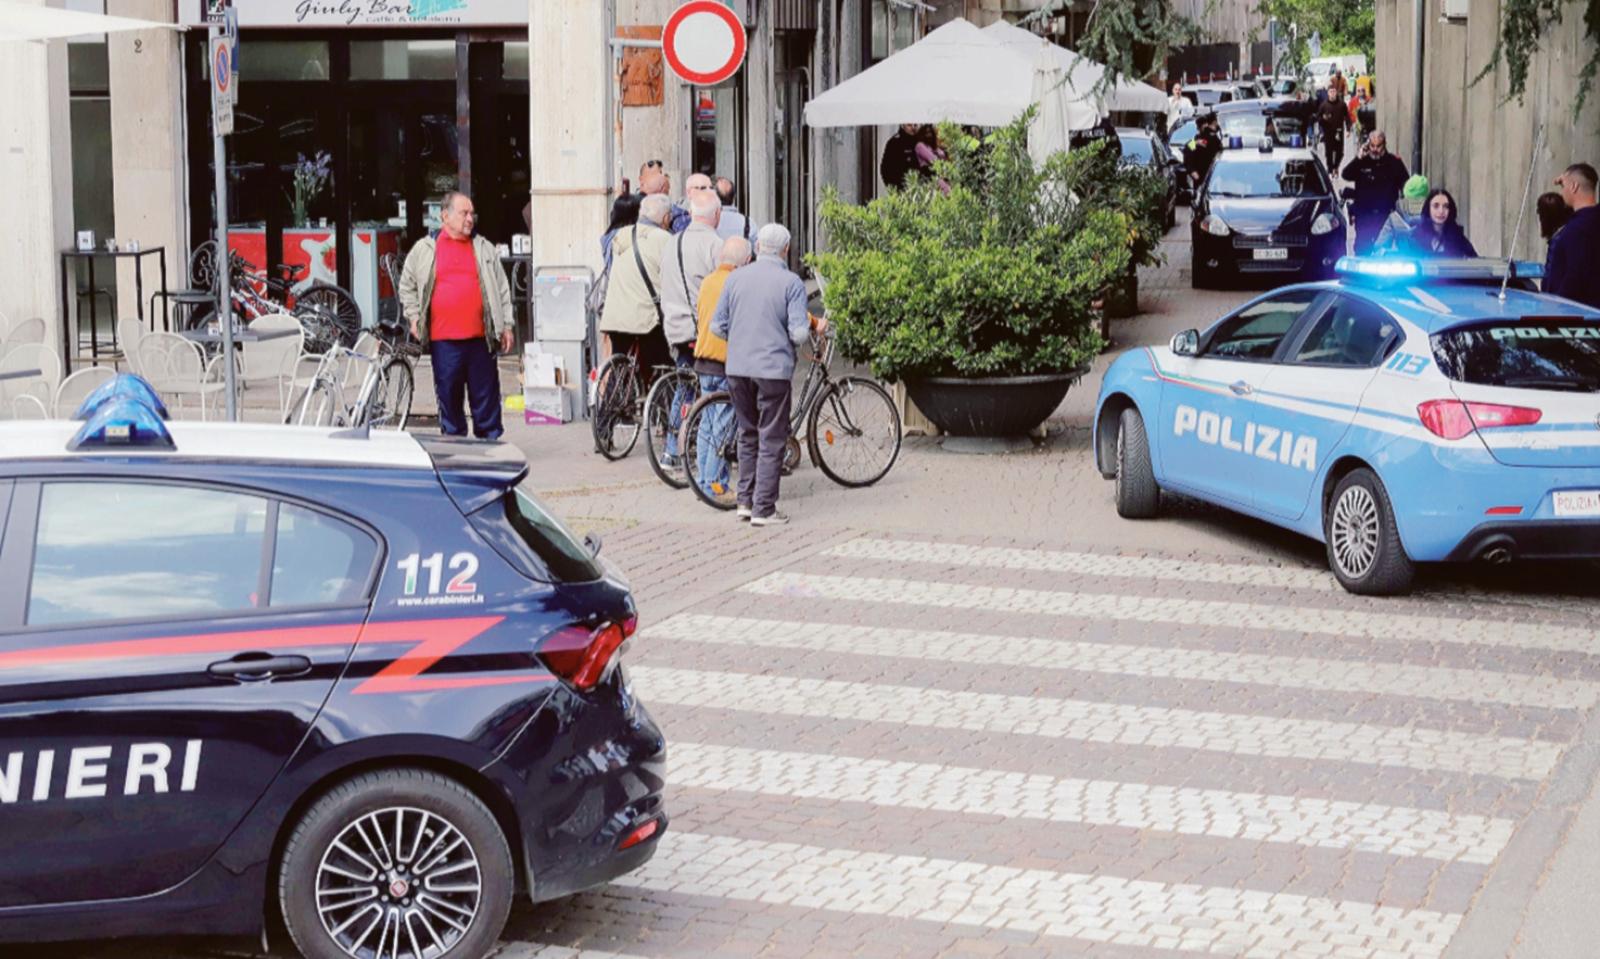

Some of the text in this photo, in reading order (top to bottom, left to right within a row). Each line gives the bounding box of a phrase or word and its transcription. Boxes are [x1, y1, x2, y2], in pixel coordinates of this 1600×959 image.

[369, 0, 416, 15] Bar
[134, 39, 143, 54] 2
[1386, 352, 1431, 376] 113
[1174, 404, 1317, 472] POLIZIA
[397, 552, 479, 595] 112
[397, 594, 485, 606] www.carabinieri.it
